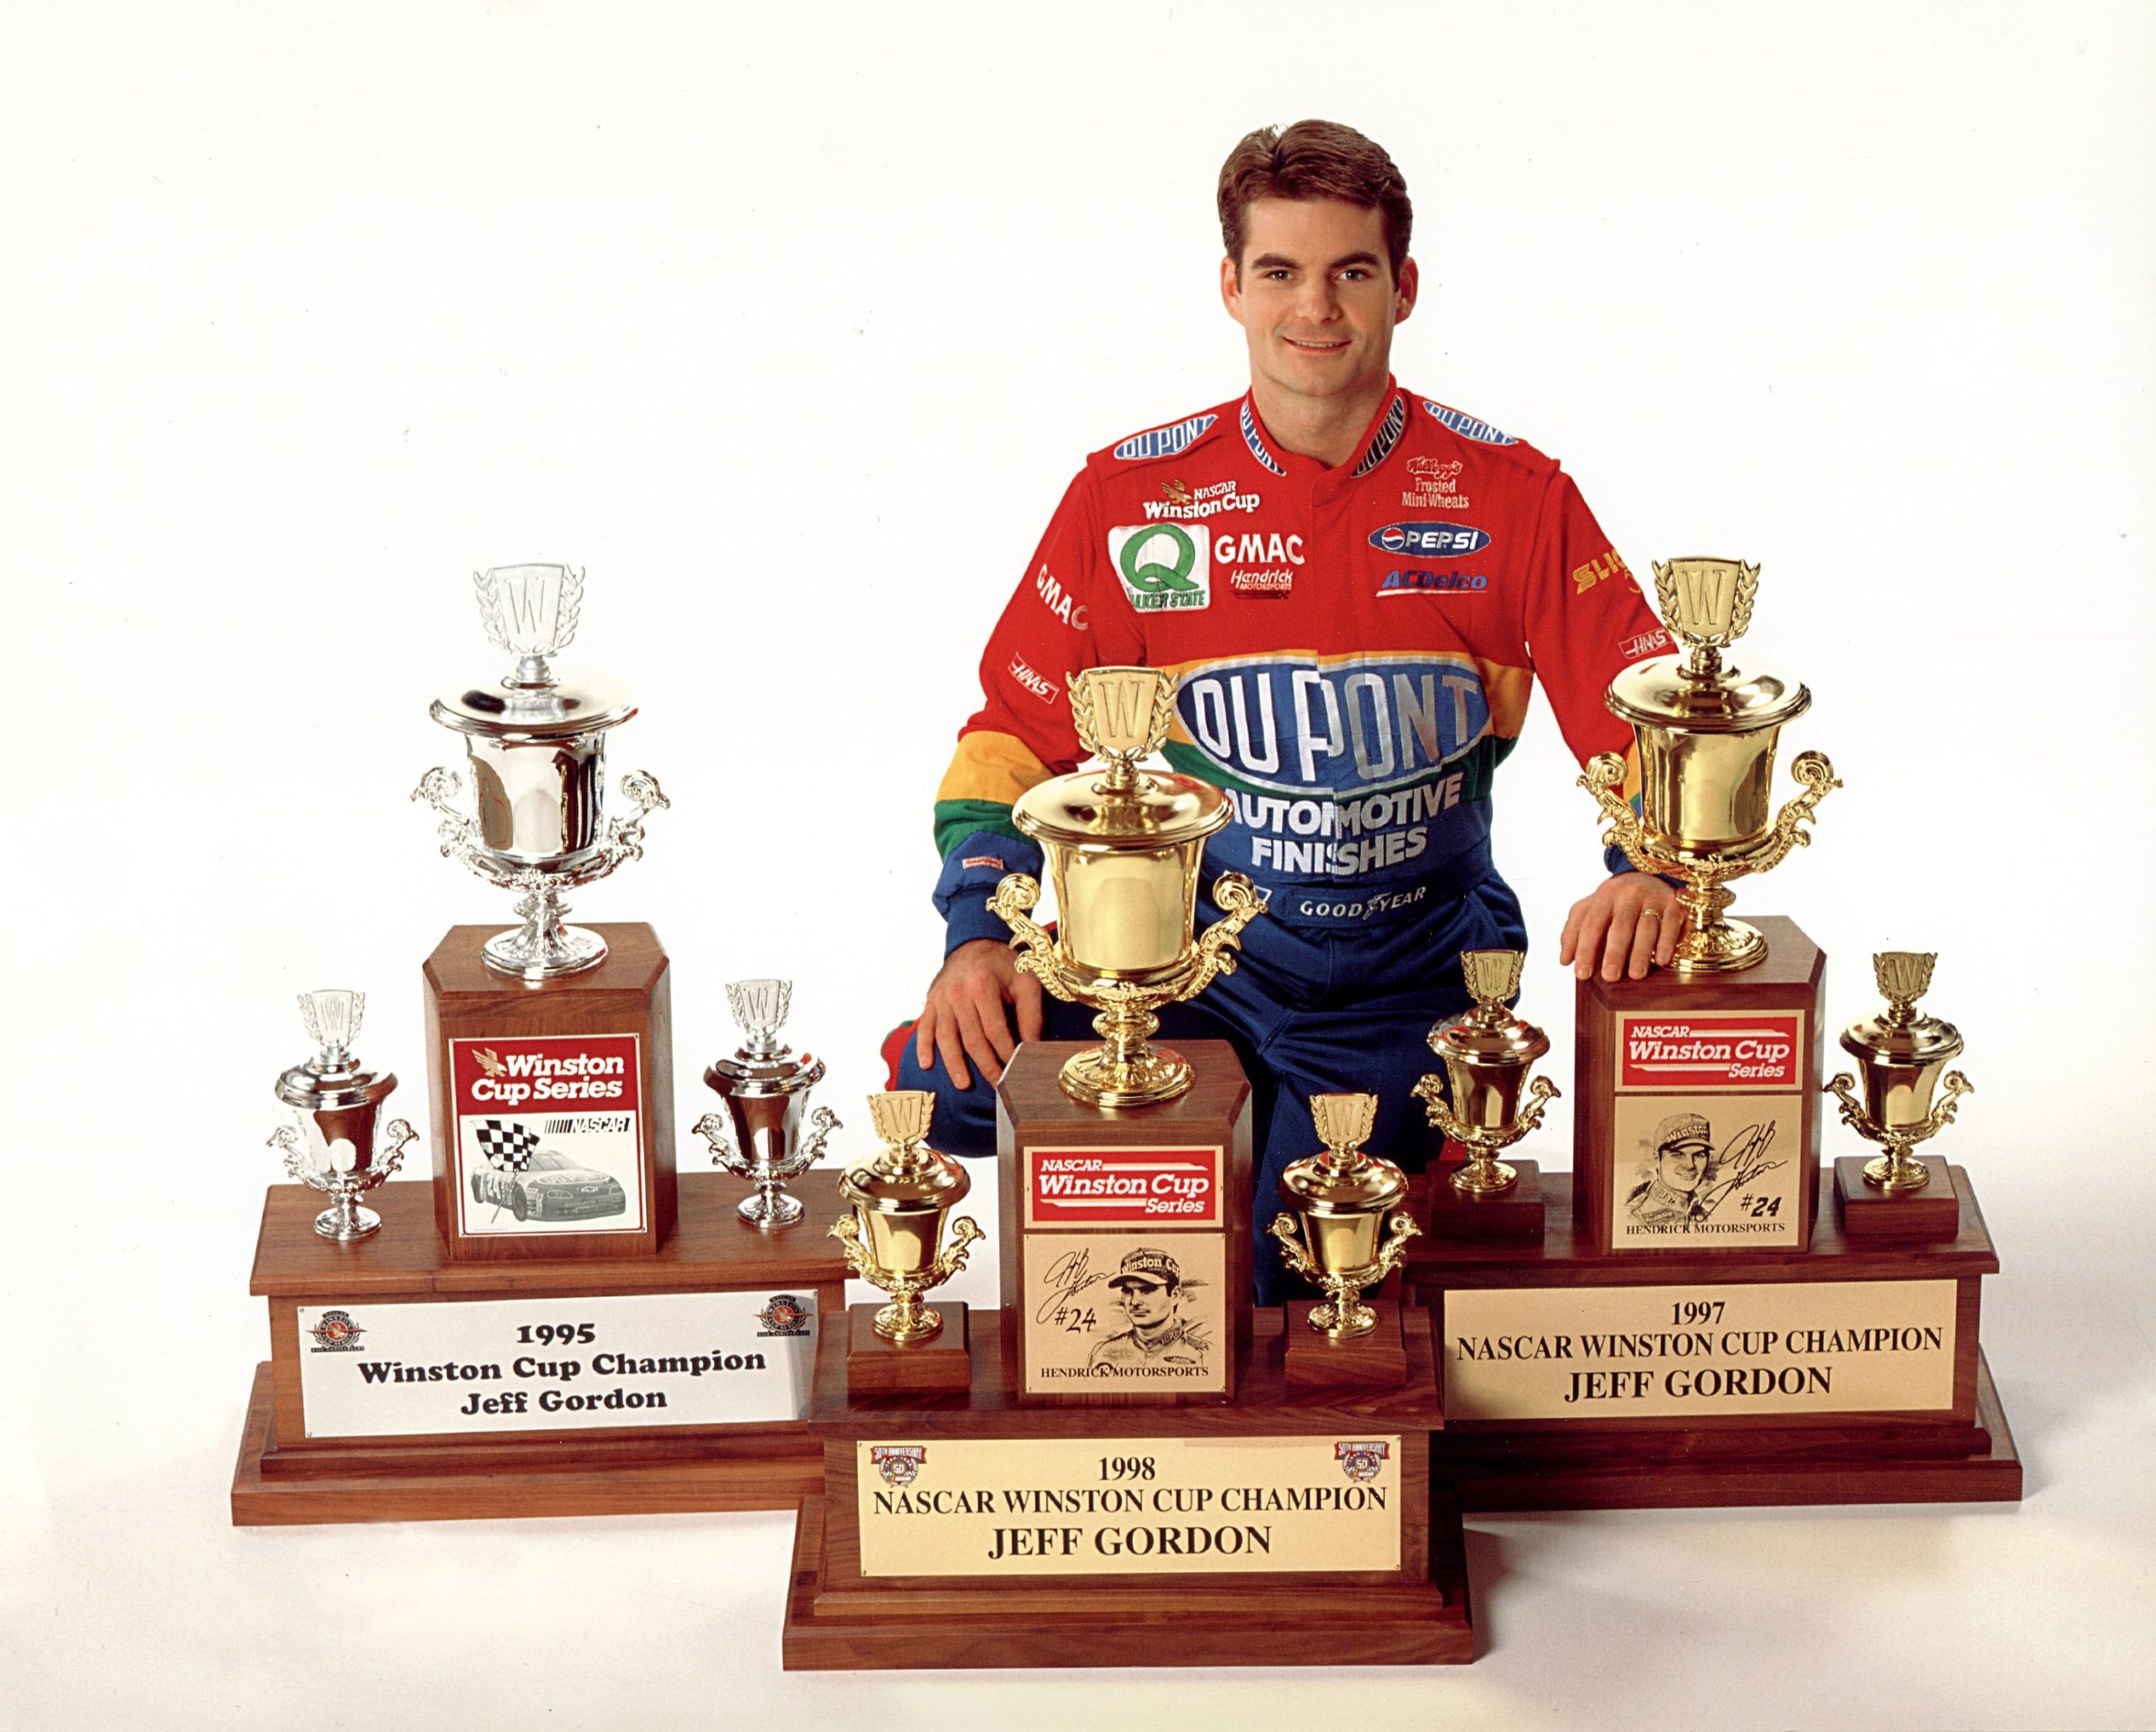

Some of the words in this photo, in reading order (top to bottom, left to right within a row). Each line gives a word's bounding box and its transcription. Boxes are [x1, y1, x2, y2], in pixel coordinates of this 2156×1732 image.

[1193, 481, 1236, 499] NASCAR
[1415, 477, 1456, 493] Frosted
[1215, 533, 1305, 565] GMAC
[1406, 530, 1479, 549] PEPSI
[1230, 568, 1293, 589] Hendrick
[1382, 570, 1488, 589] ACDelco
[504, 577, 552, 634] W
[1037, 563, 1088, 630] GMAC
[1169, 590, 1205, 607] STATE
[1682, 569, 1729, 626] W
[1098, 680, 1145, 738] W
[1251, 826, 1427, 876] FINISHES
[1631, 1026, 1690, 1038] NASCAR
[1629, 1040, 1730, 1061] Winston
[1735, 1040, 1790, 1063] Cup
[506, 1053, 624, 1077] Winston
[1728, 1063, 1785, 1079] Series
[472, 1079, 531, 1106] Cup
[533, 1076, 622, 1100] Series
[572, 1117, 631, 1133] NASCAR
[1041, 1159, 1102, 1172] NASCAR
[1038, 1174, 1147, 1196] Winston
[1151, 1174, 1209, 1198] Cup
[1145, 1198, 1204, 1213] Series
[1740, 1193, 1782, 1218] #24
[1626, 1224, 1691, 1234] HENDRICK
[1694, 1223, 1785, 1234] MOTORSPORTS
[1054, 1307, 1097, 1334] #24
[1671, 1302, 1726, 1325] 1997
[516, 1323, 595, 1346] 1995
[1457, 1335, 1573, 1361] NASCAR
[1580, 1333, 1714, 1358] WINSTON
[1721, 1331, 1778, 1356] CUP
[1785, 1327, 1943, 1354] CHAMPION
[357, 1362, 502, 1384] Winston
[513, 1356, 581, 1381] Cup
[592, 1350, 766, 1376] Champion
[1041, 1367, 1109, 1378] HENDRICK
[1113, 1367, 1209, 1378] MOTORSPORTS
[1564, 1371, 1654, 1403] JEFF
[1665, 1367, 1833, 1397] GORDON
[461, 1392, 528, 1415] Jeff
[539, 1388, 667, 1412] Gordon
[1098, 1457, 1155, 1480] 1998
[873, 1490, 995, 1515] NASCAR
[1002, 1489, 1144, 1513] WINSTON
[1153, 1489, 1213, 1511] CUP
[1221, 1487, 1387, 1511] CHAMPION
[988, 1527, 1083, 1559] JEFF
[1094, 1526, 1272, 1555] GORDON
